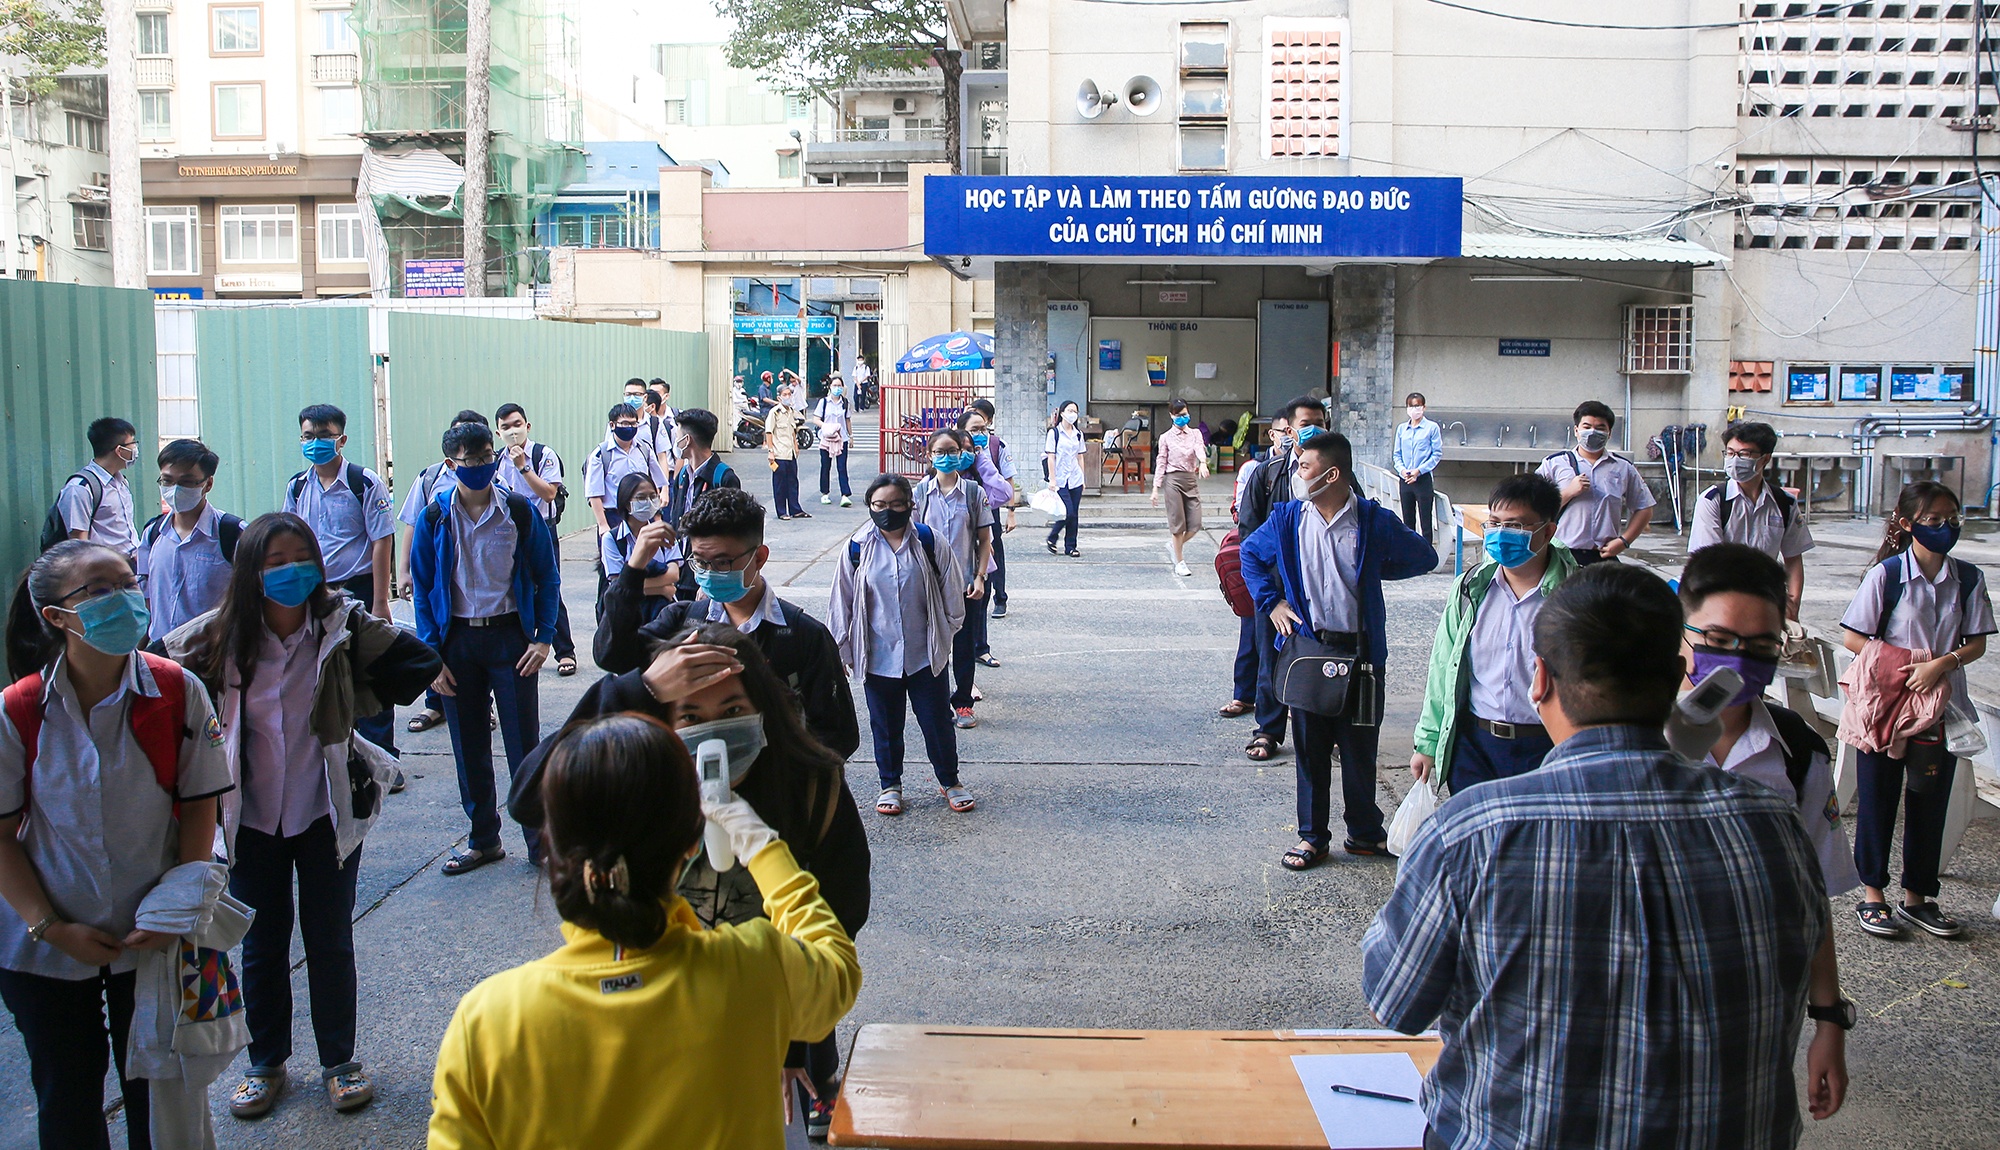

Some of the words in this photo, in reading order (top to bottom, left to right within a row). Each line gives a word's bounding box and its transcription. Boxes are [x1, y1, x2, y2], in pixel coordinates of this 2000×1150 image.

[195, 166, 216, 176] TNHH
[241, 165, 256, 177] SẠN
[257, 163, 277, 175] PHÚC
[277, 165, 297, 175] LONG
[965, 188, 1006, 214] HỌC
[1012, 184, 1051, 212] TẬP
[1057, 184, 1082, 209] VÀ
[1090, 184, 1132, 209] LÀM
[1138, 190, 1190, 209] THEO
[1198, 182, 1241, 209] TẤM
[1249, 186, 1317, 210] GƯƠNG
[1322, 190, 1363, 214] ĐẠO
[1369, 186, 1411, 211] ĐỨC
[1049, 217, 1090, 244] CỦA
[1096, 217, 1136, 244] CHỦ
[1142, 224, 1188, 247] TỊCH
[1198, 216, 1225, 244] HỒ
[1231, 218, 1266, 244] CHÍ
[1272, 224, 1322, 244] MINH
[1061, 303, 1079, 311] BÁO
[741, 319, 756, 329] PHỐ
[757, 320, 772, 328] VĂN
[1148, 320, 1178, 331] THÔNG
[1180, 320, 1198, 331] BÁO
[604, 976, 638, 990] ITALIA
